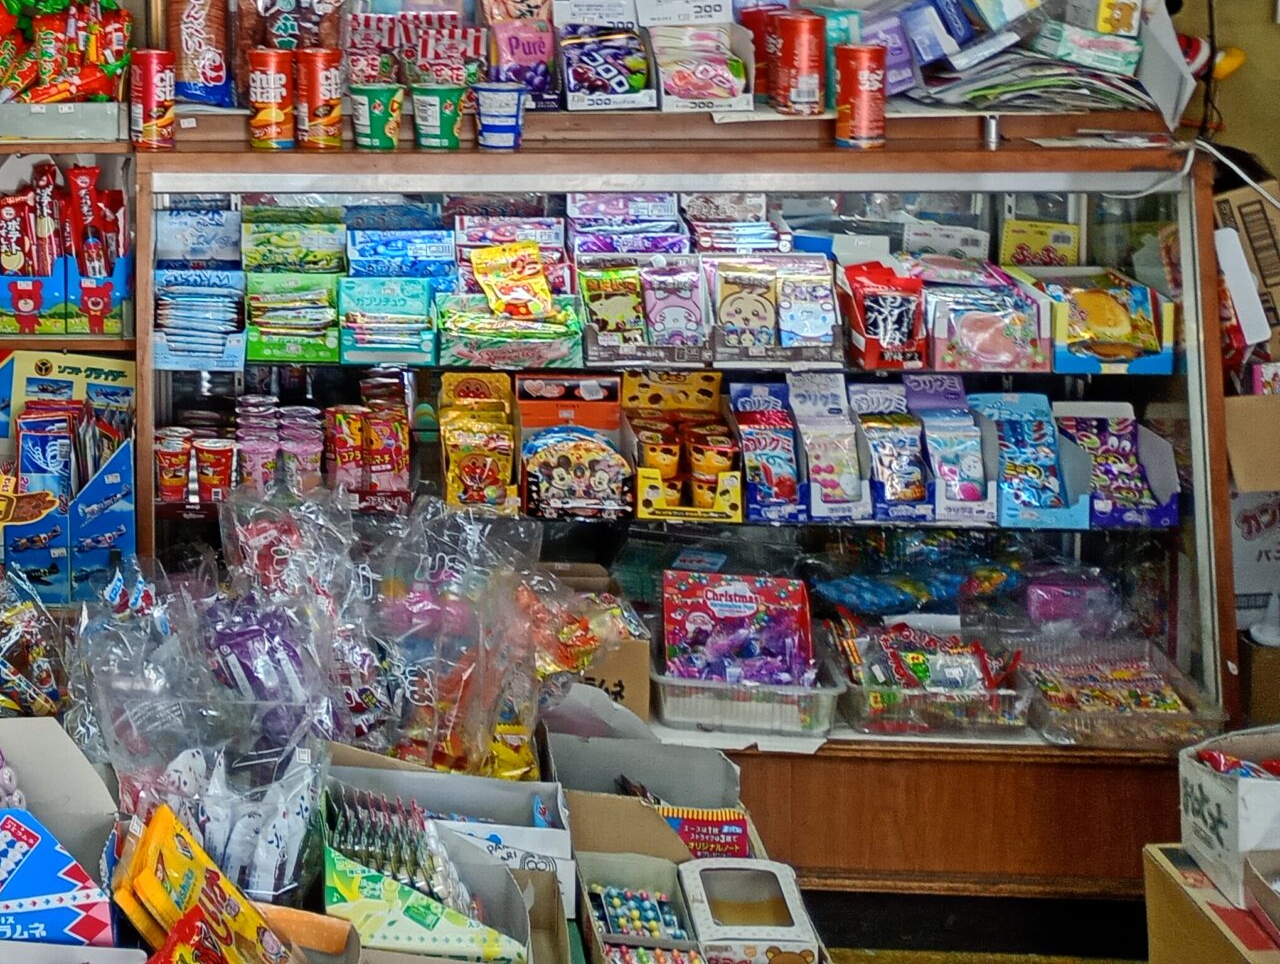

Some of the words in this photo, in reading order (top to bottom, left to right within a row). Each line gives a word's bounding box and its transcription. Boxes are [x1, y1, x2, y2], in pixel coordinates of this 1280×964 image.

[507, 34, 547, 57] Puré
[250, 70, 287, 88] chip
[579, 53, 631, 94] コロロ
[249, 85, 285, 104] star
[5, 220, 22, 255] ポテト
[57, 365, 83, 377] ソフト
[704, 587, 760, 606] Christmas
[688, 841, 741, 852] オリジナルノート
